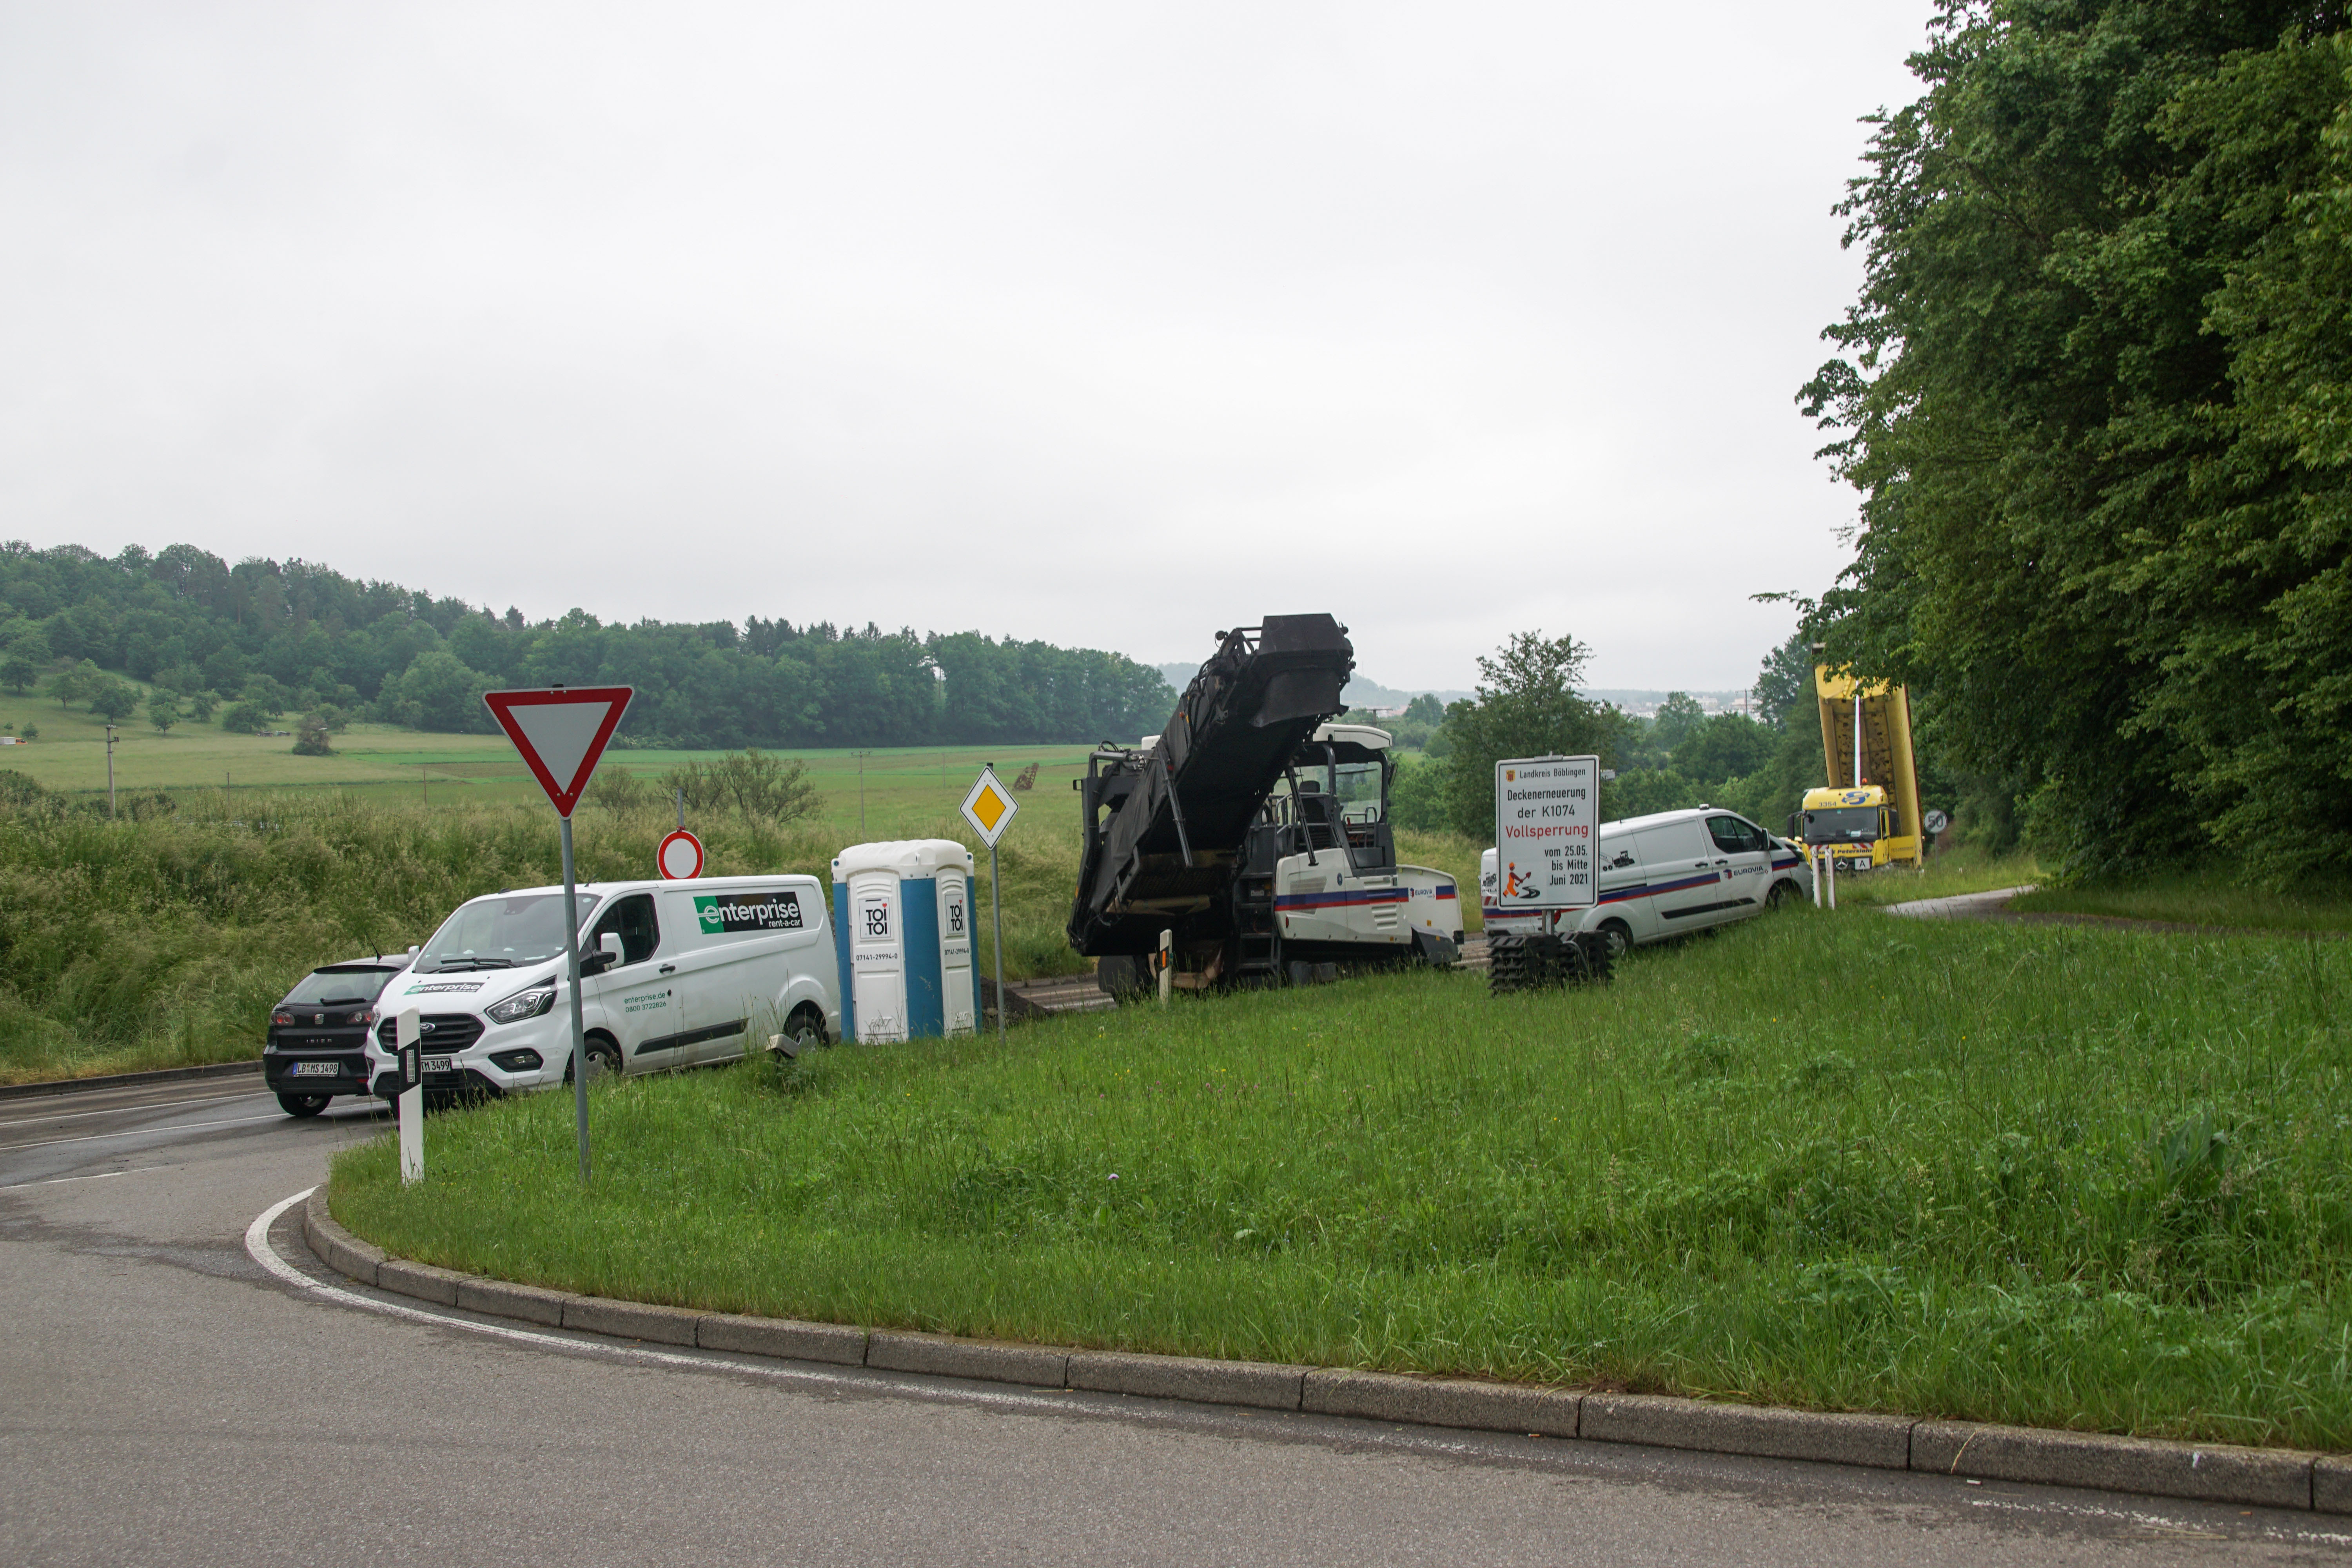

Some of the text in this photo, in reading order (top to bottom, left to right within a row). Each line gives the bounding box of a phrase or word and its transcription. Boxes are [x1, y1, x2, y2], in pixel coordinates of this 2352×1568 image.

[1520, 768, 1586, 779] Landkreis Böblingen
[1508, 788, 1586, 801] Deckenerneuerung
[1518, 805, 1575, 818] der K1074
[1927, 815, 1943, 827] 50
[1506, 825, 1588, 840] Vollsperrung
[1545, 845, 1588, 857] vom 25.05.
[1552, 860, 1588, 871] bis Mitte
[1859, 860, 1866, 868] A
[1734, 865, 1763, 876] EUROVIA
[1550, 874, 1588, 886] Juni 2021
[698, 898, 799, 925] enterprise
[866, 908, 887, 922] TOI
[950, 904, 962, 918] TOI
[768, 919, 801, 928] rent-a-car
[866, 922, 887, 935] TOI
[951, 918, 963, 931] TOI
[408, 983, 481, 993] enterprise
[624, 992, 666, 1004] enterprise.de
[642, 1001, 666, 1010] 3722826
[298, 1063, 338, 1073] LB MS 1498
[431, 1060, 450, 1071] 3499
